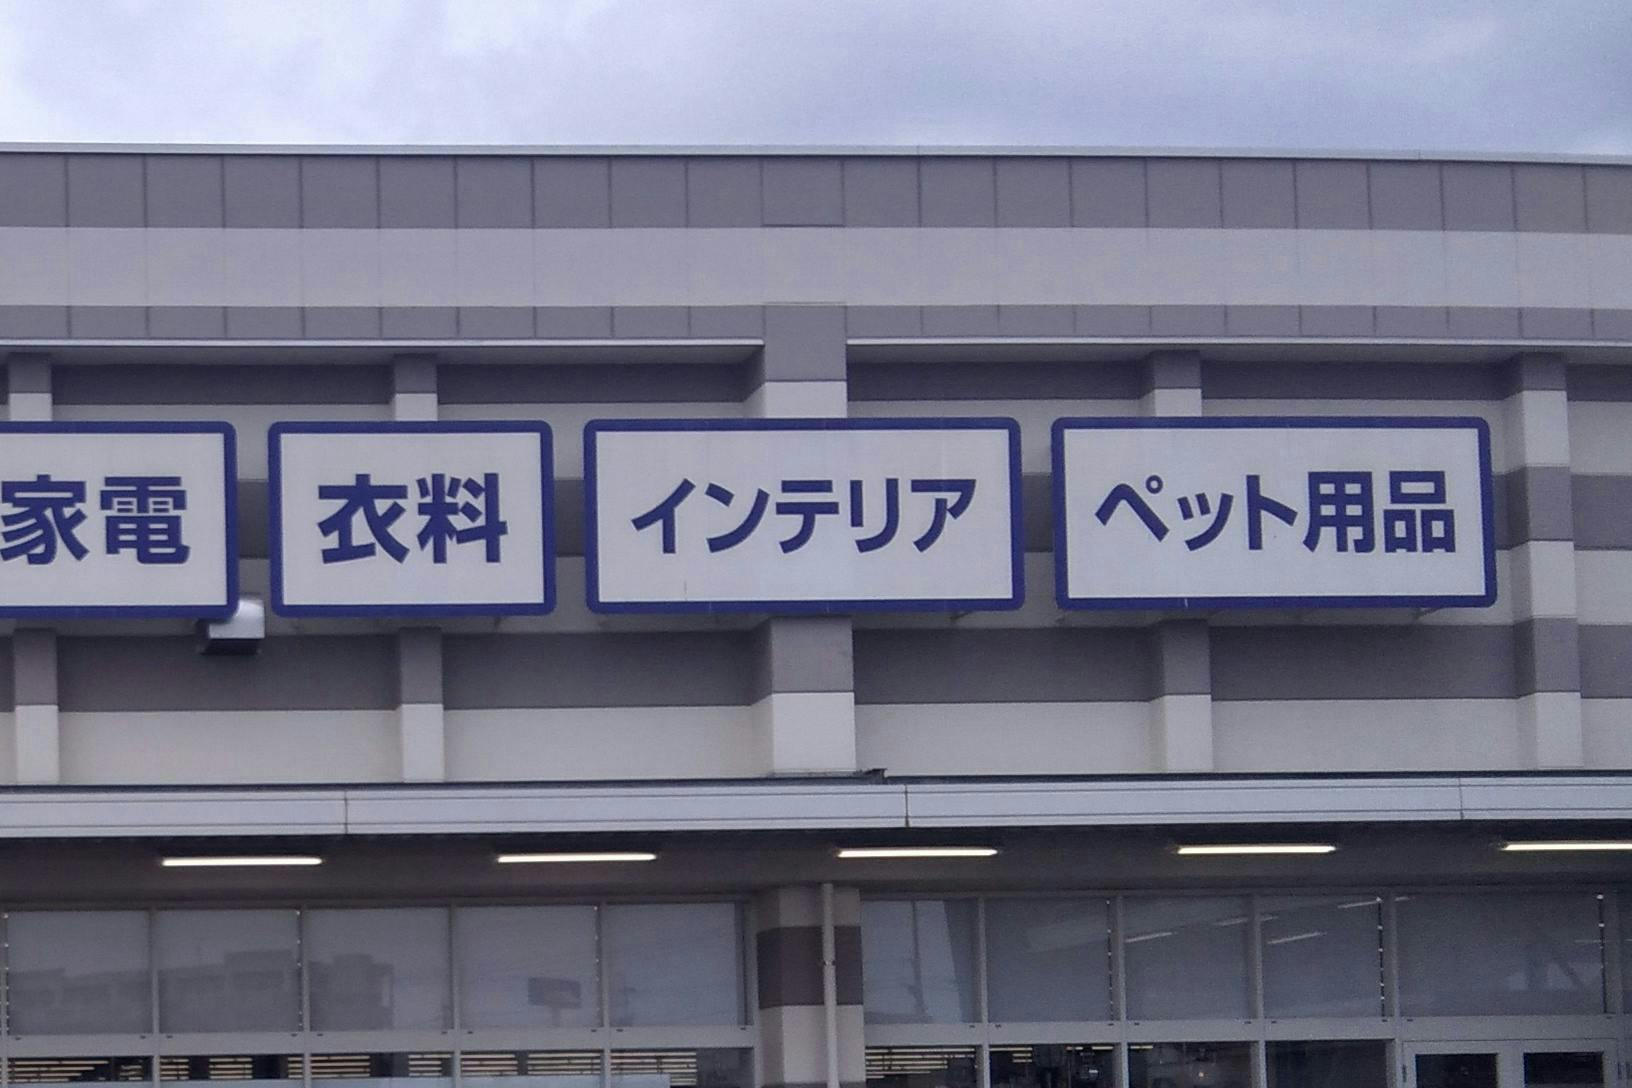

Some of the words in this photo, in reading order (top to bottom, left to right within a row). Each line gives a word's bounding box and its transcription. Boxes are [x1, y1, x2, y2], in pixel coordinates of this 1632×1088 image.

[0, 474, 190, 565] 家電
[317, 473, 508, 564] 衣料
[631, 478, 976, 554] インテリア
[1095, 471, 1456, 553] ペット用品
